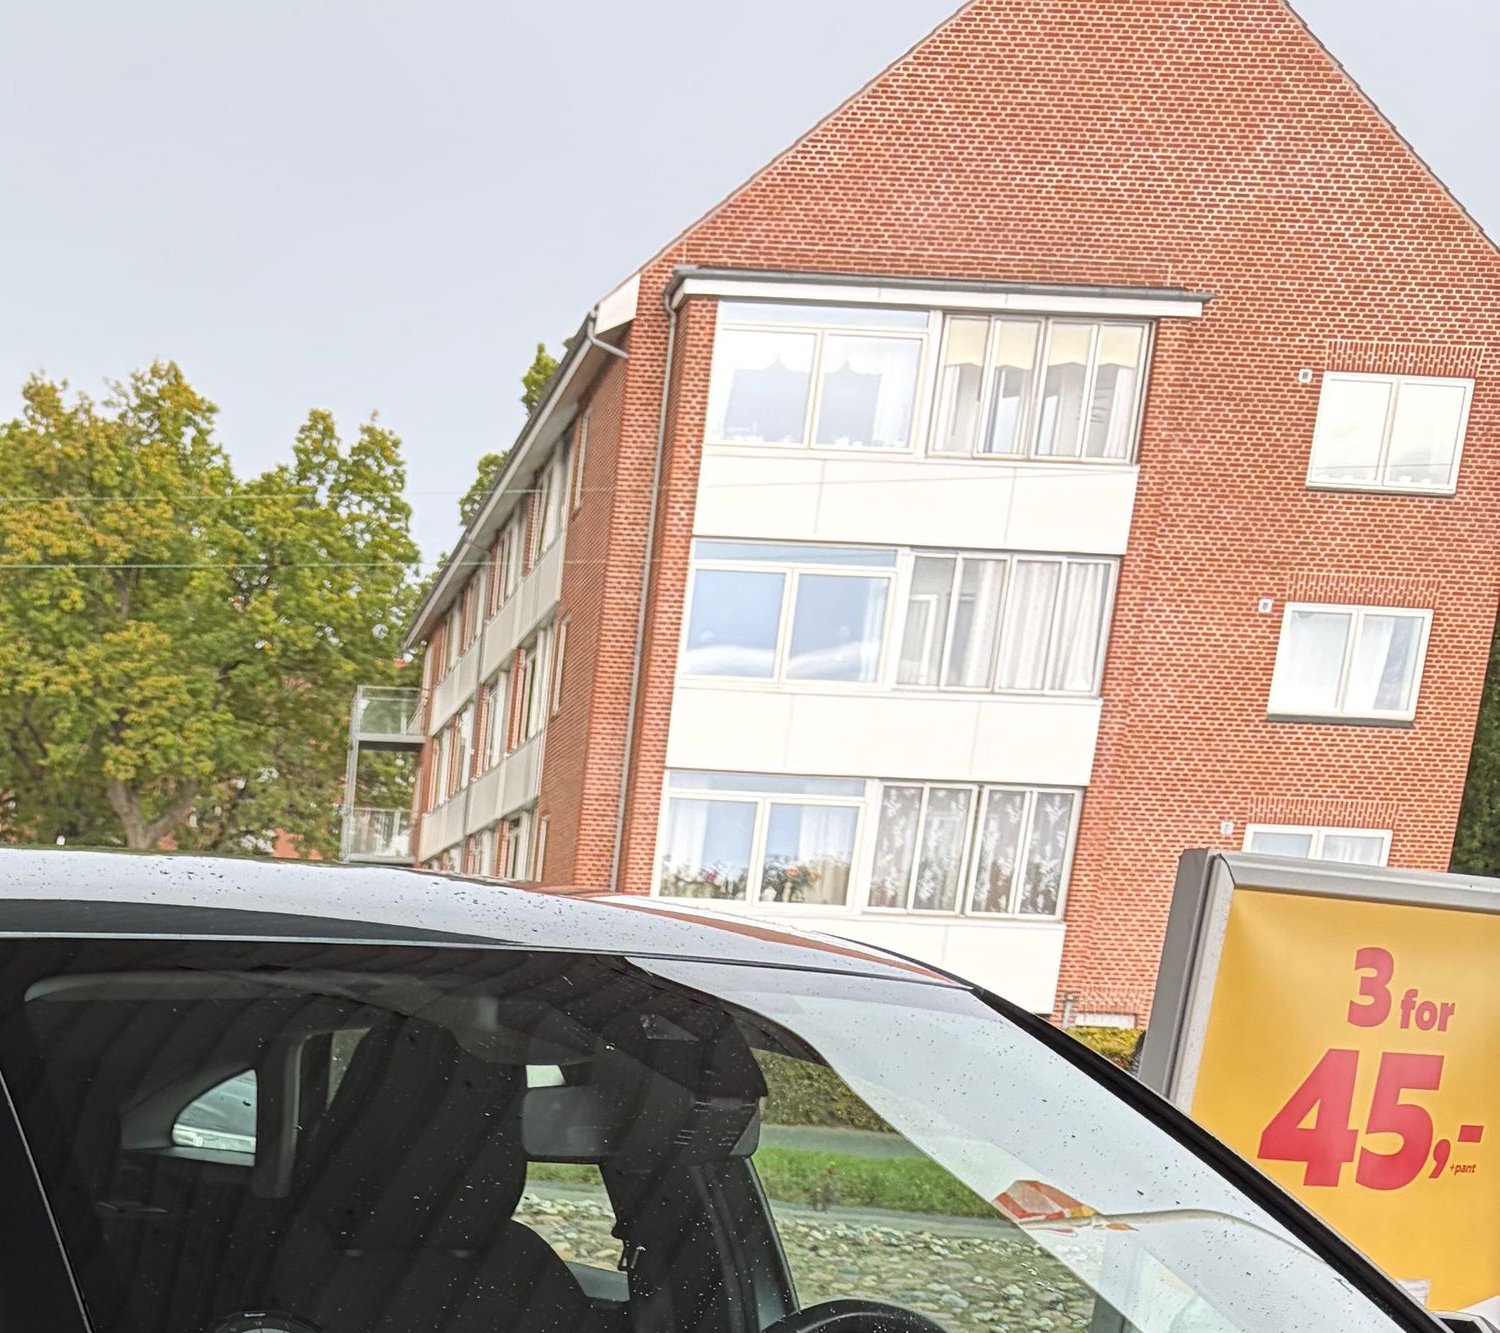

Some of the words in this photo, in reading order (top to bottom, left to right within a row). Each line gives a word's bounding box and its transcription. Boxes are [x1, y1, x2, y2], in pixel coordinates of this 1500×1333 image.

[1347, 947, 1395, 1028] 3
[1400, 989, 1456, 1032] for
[1256, 1048, 1485, 1191] 45,-
